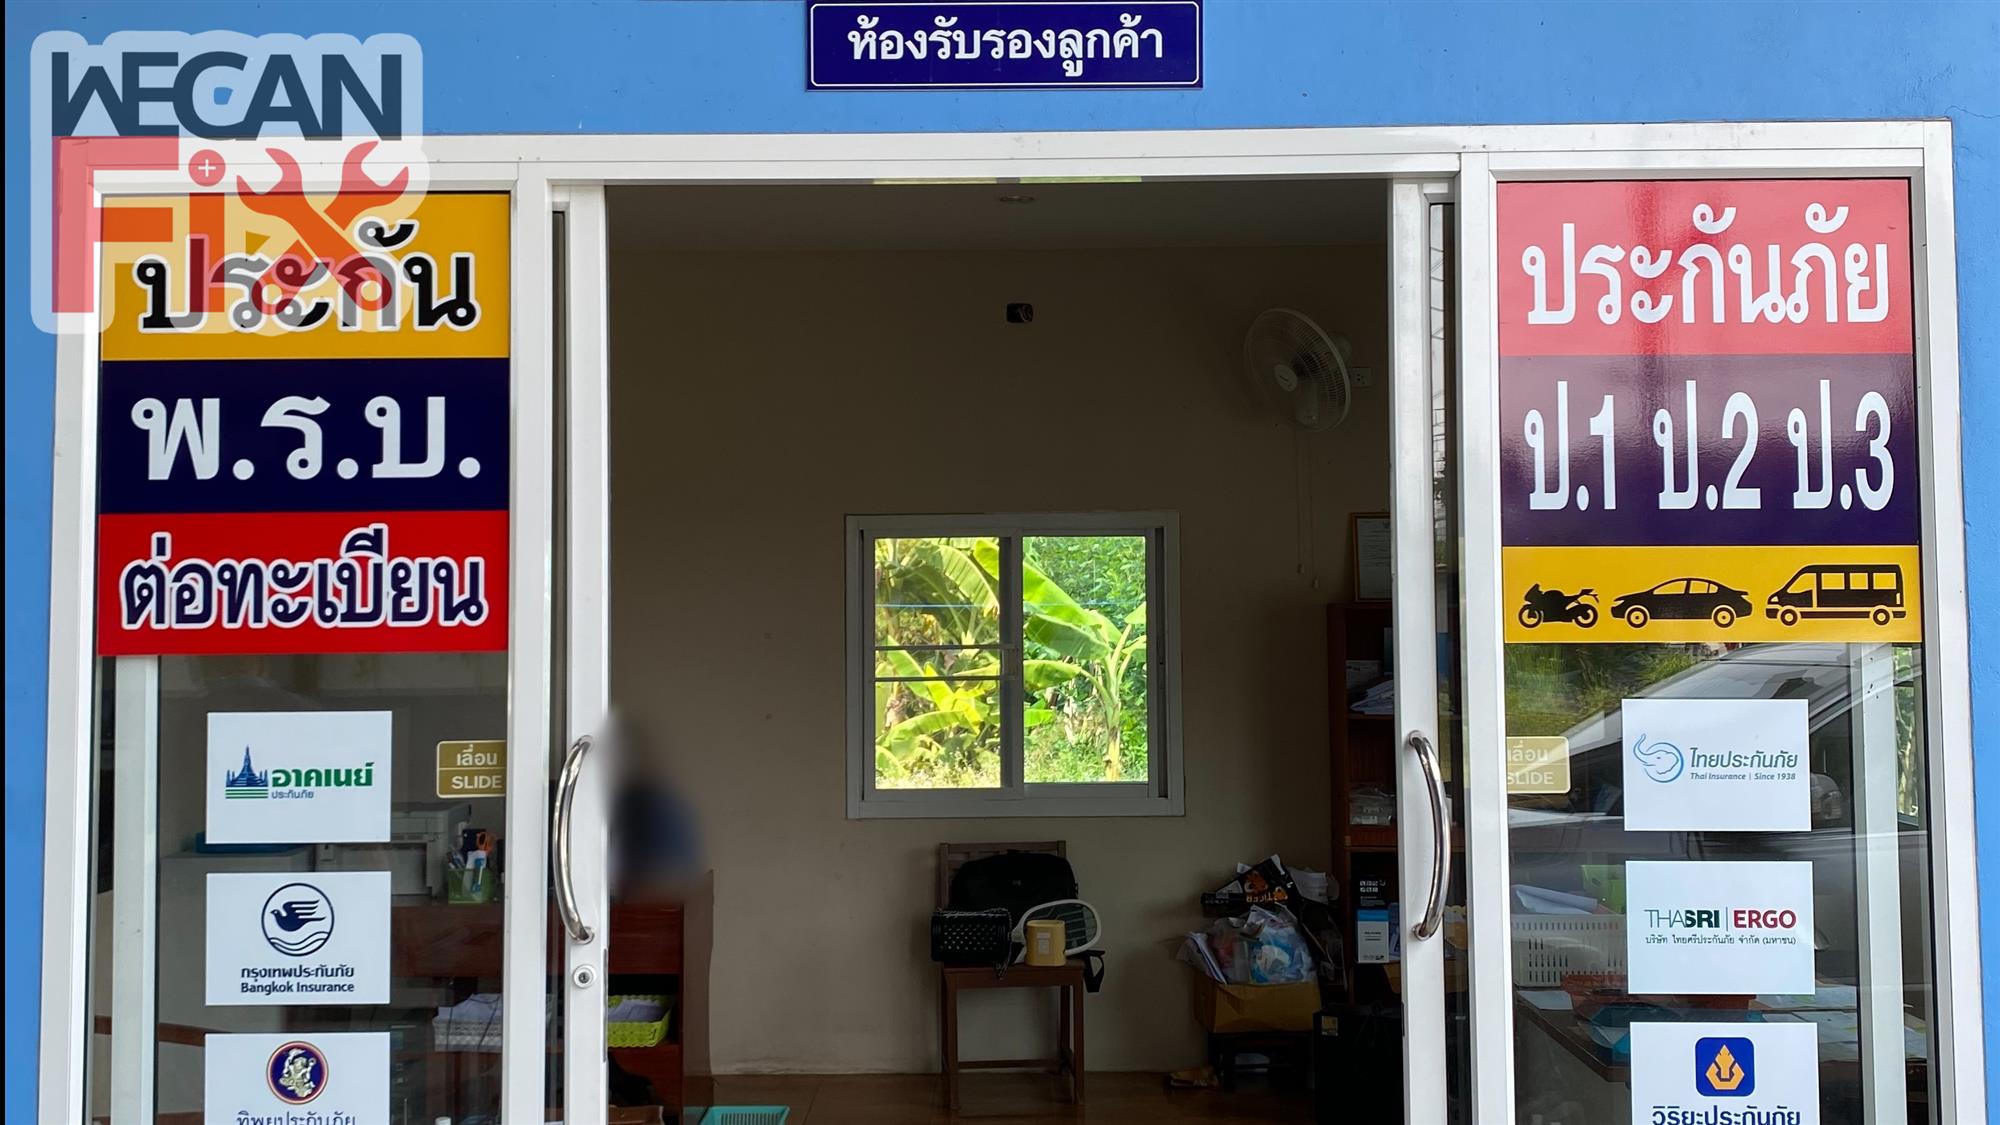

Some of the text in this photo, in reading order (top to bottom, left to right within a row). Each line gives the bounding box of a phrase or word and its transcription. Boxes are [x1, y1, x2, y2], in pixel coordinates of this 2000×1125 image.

[848, 13, 1163, 77] ห้องรับรองลูกค้า
[1521, 202, 1890, 325] ประกันภัย
[135, 218, 479, 332] ประกัน
[131, 395, 481, 480] พ.ร.บ.
[1523, 379, 1895, 511] ป.1 ป.2 ป.3
[121, 524, 488, 630] ต่อทะเบียน
[457, 744, 498, 766] เลื่อน
[1690, 747, 1798, 768] ไทยประกันภัย
[271, 761, 375, 787] อาคเนย์
[451, 775, 503, 789] SLIDE
[1507, 771, 1554, 785] SLIDE
[1690, 772, 1796, 780] Thai Insurance Since 1938
[271, 789, 315, 799] ประกันภัย
[1733, 909, 1797, 929] ERGO
[1645, 933, 1796, 945] บริษัท ไทยศรีประกันภัย จำกัด (มหาชน)
[241, 964, 355, 982] กรุงเทพประกันภัย
[241, 981, 355, 995] Bangkok Insurance
